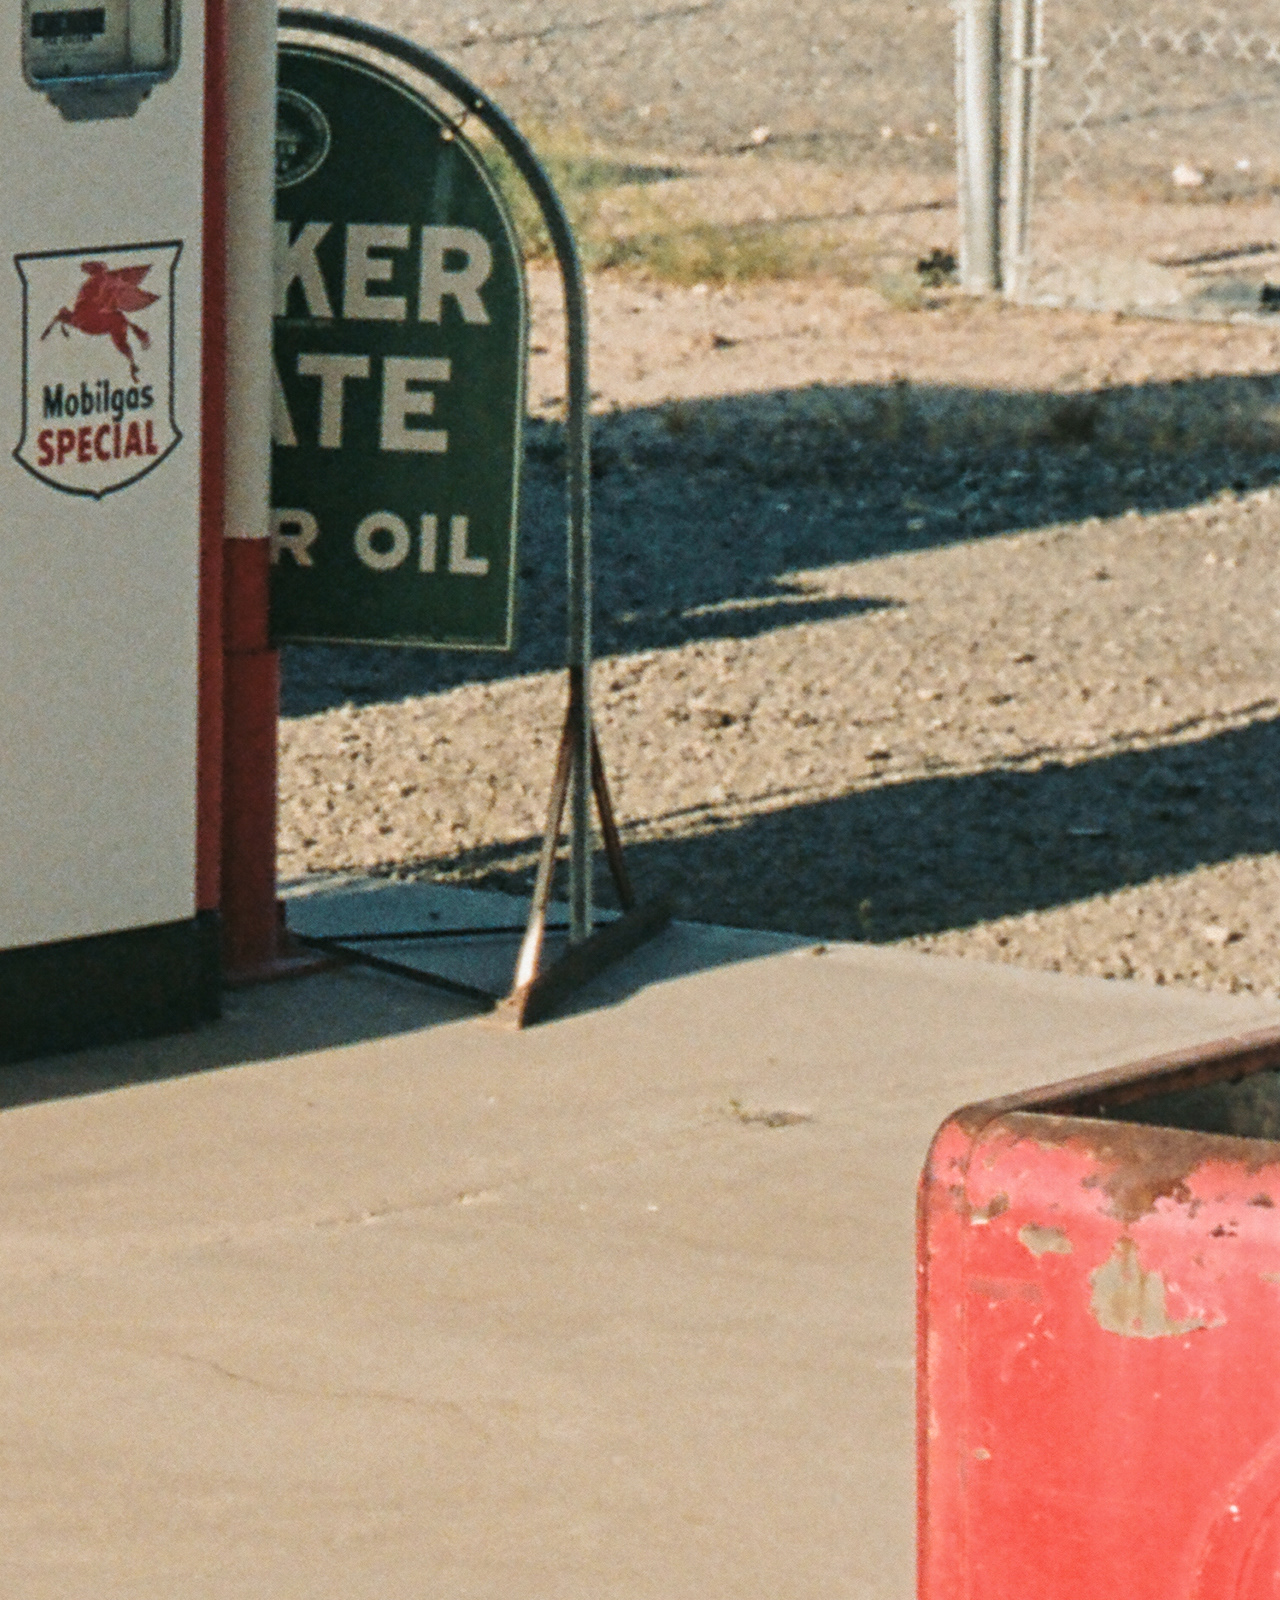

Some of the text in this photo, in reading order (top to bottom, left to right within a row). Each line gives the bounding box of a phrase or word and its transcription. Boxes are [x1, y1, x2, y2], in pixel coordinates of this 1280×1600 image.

[42, 380, 155, 422] Mobilgas
[37, 421, 159, 467] SPECIAL
[353, 509, 490, 578] OIL
